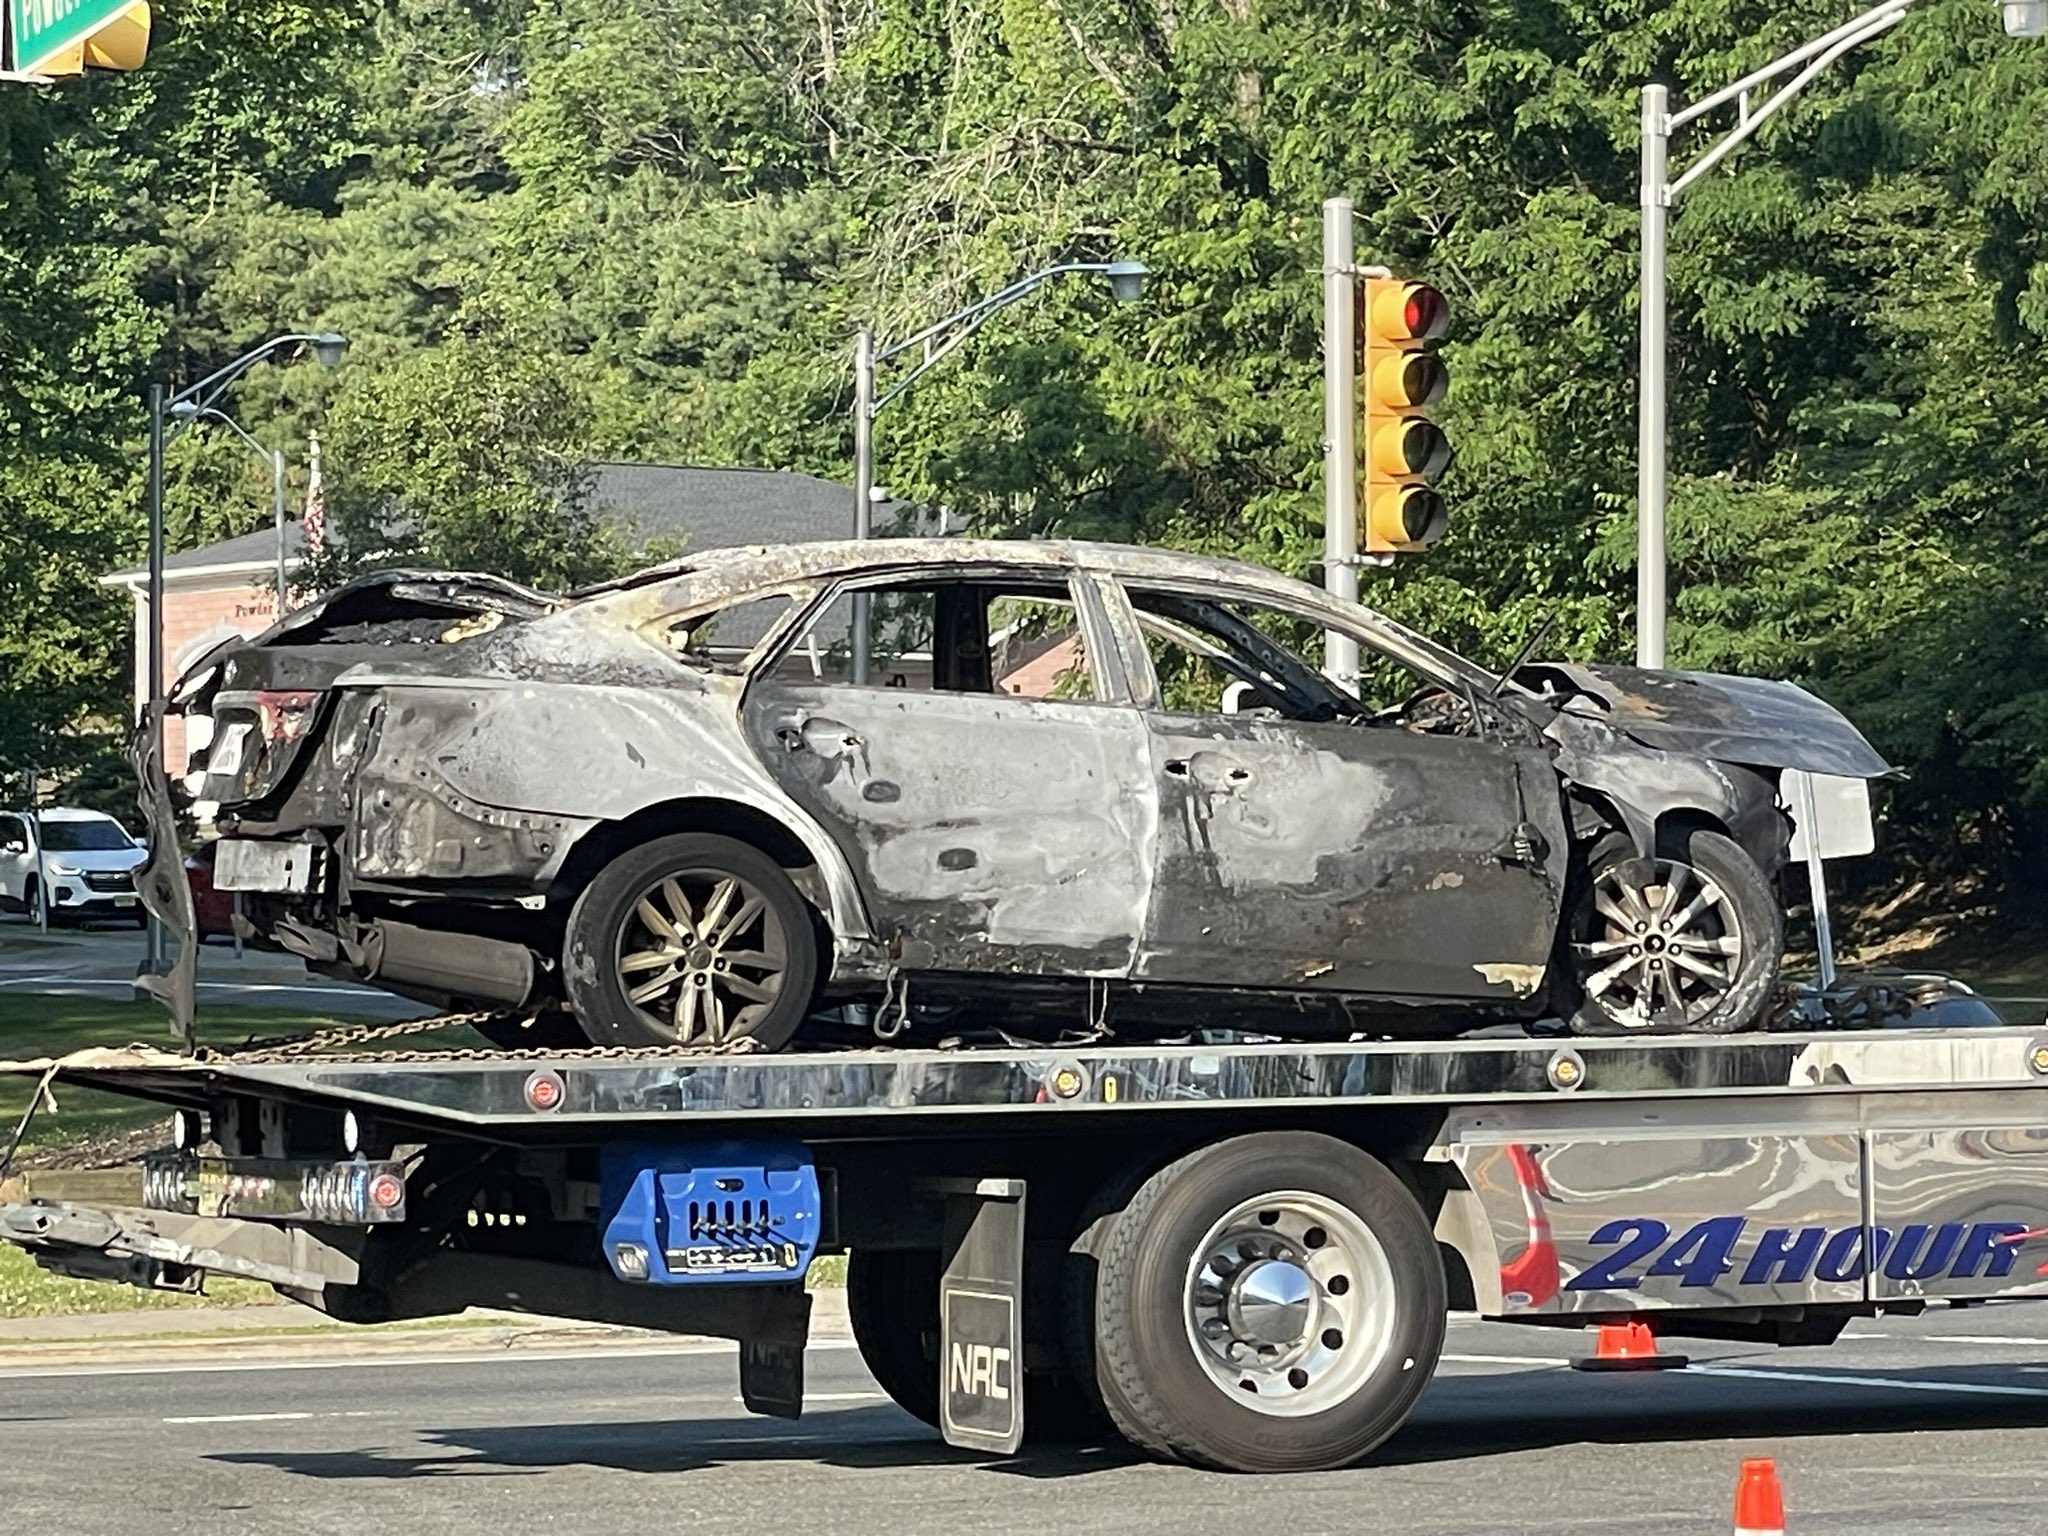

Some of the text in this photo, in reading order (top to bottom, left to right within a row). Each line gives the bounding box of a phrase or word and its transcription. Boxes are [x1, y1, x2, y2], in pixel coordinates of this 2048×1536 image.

[1564, 1216, 2029, 1290] 24 HOUR
[951, 1342, 1010, 1400] NRC
